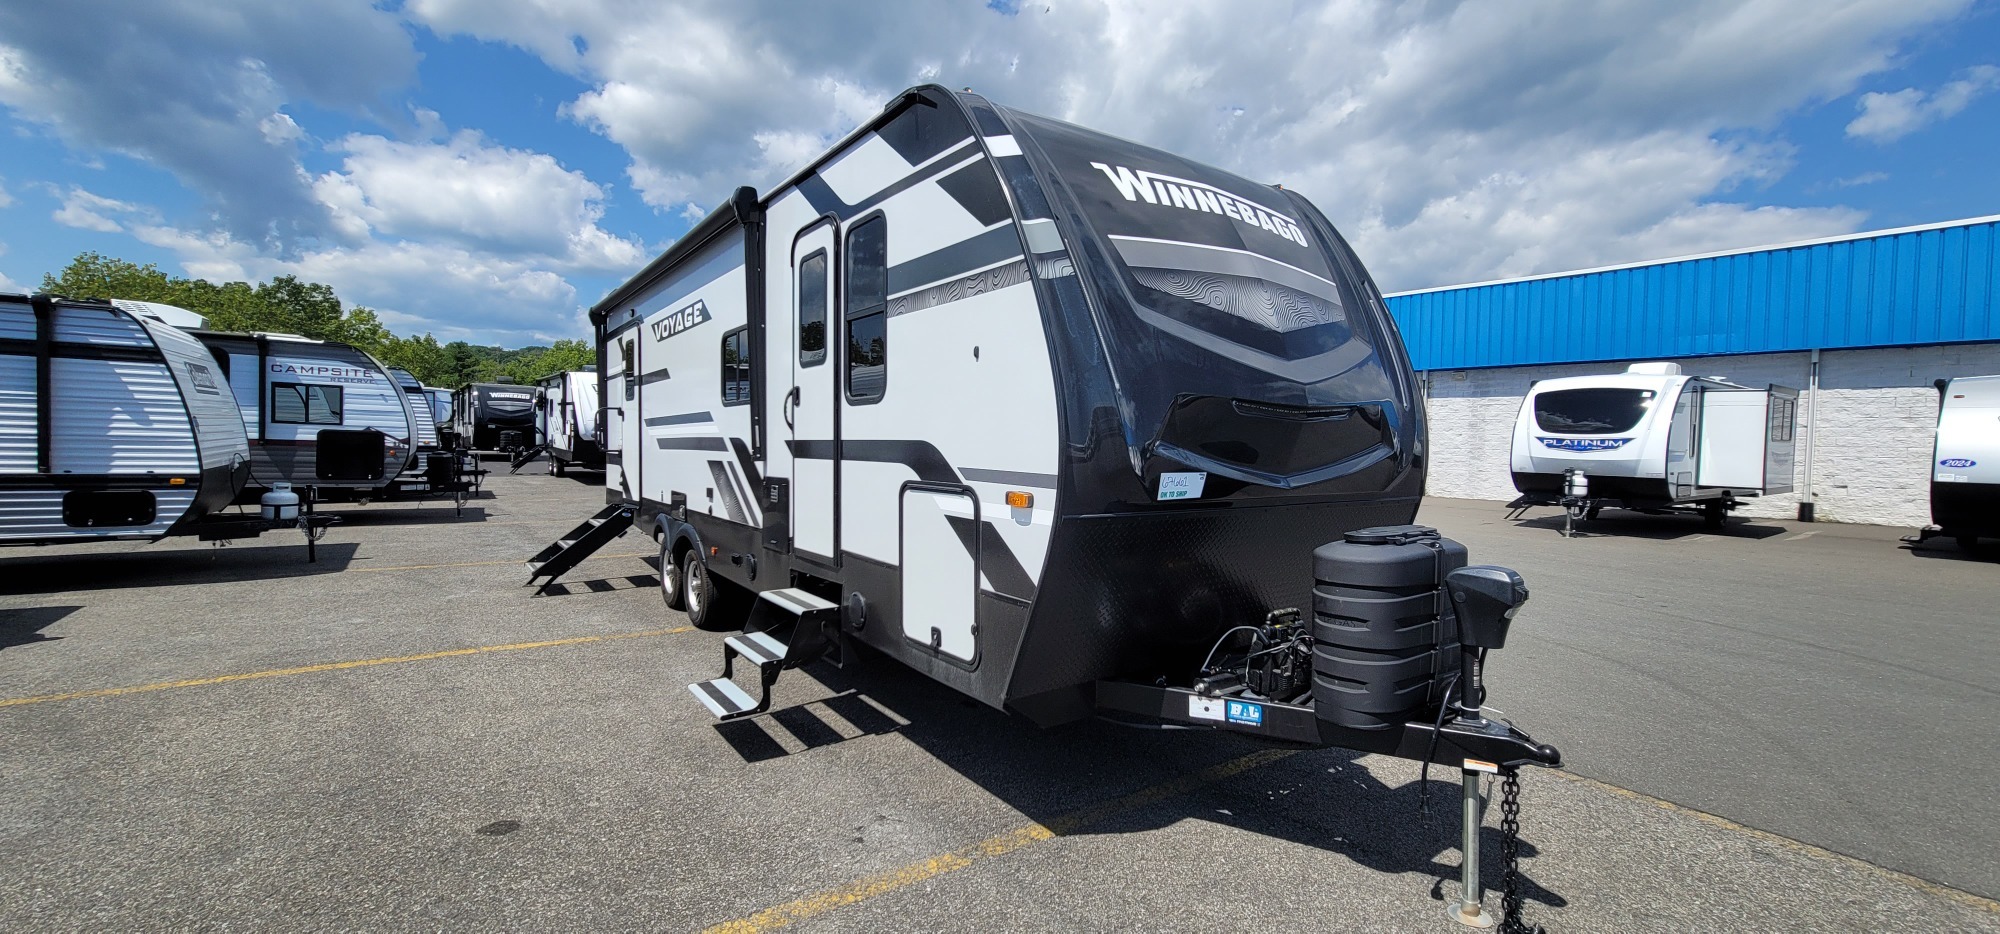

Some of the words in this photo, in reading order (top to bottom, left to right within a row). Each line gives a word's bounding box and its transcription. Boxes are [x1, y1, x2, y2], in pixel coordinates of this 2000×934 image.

[1090, 161, 1308, 248] WINNEBAGO
[654, 302, 703, 341] VOYAGE
[271, 364, 373, 377] CAMPSITE
[1543, 439, 1624, 447] PLATINUM
